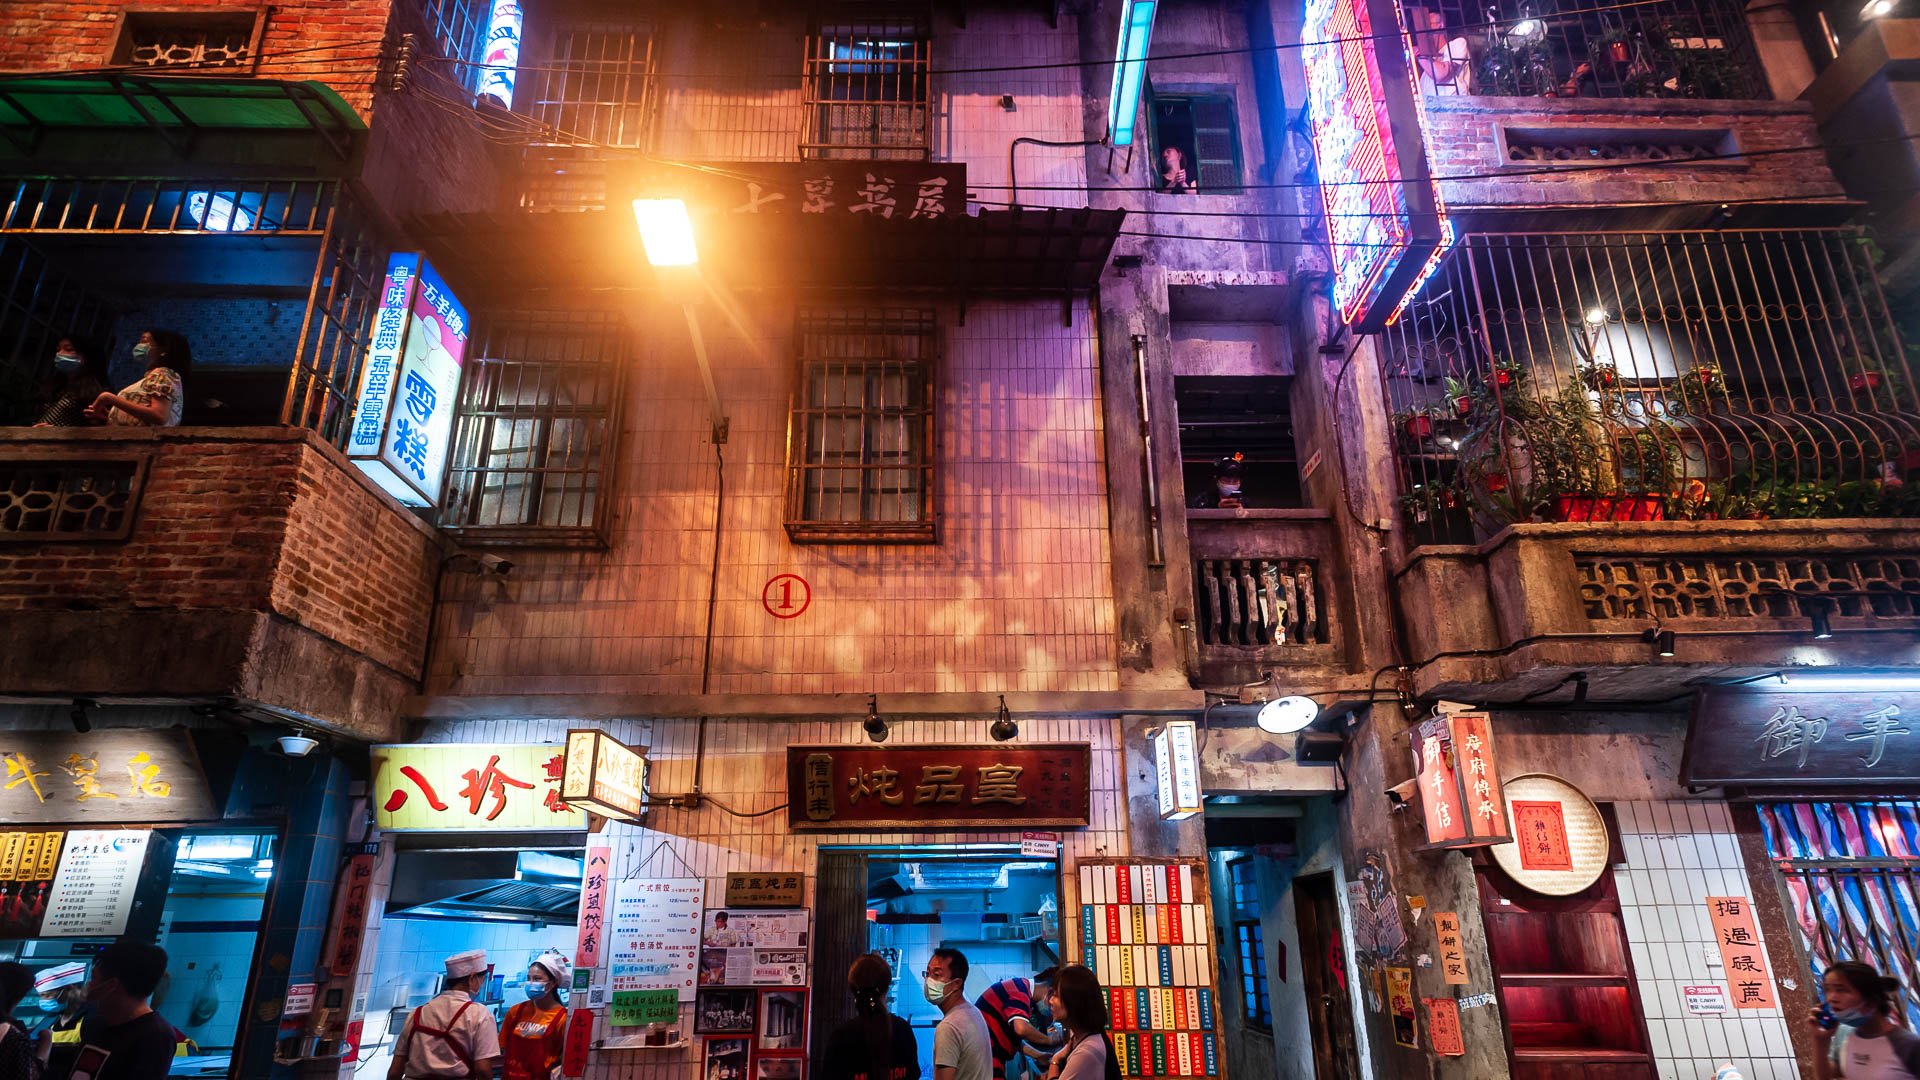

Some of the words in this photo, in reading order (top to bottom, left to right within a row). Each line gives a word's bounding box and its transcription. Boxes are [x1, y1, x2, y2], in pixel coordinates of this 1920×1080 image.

[376, 265, 409, 350] 粤味经典
[422, 281, 463, 340] 五羊牌
[355, 355, 392, 446] 五羊雪糕
[392, 369, 438, 481] 雪糕
[1754, 704, 1912, 769] 御手
[383, 754, 537, 821] 八珍
[807, 759, 832, 815] 信行丰
[848, 763, 1028, 808] 炖品皇
[1423, 734, 1453, 830] 御手信
[1464, 733, 1499, 821] 廣府傳承
[364, 842, 379, 854] 178
[581, 856, 607, 953] 八珍煎饺香
[638, 883, 671, 893] 广式煎饺
[630, 941, 664, 950] 特色汤饮
